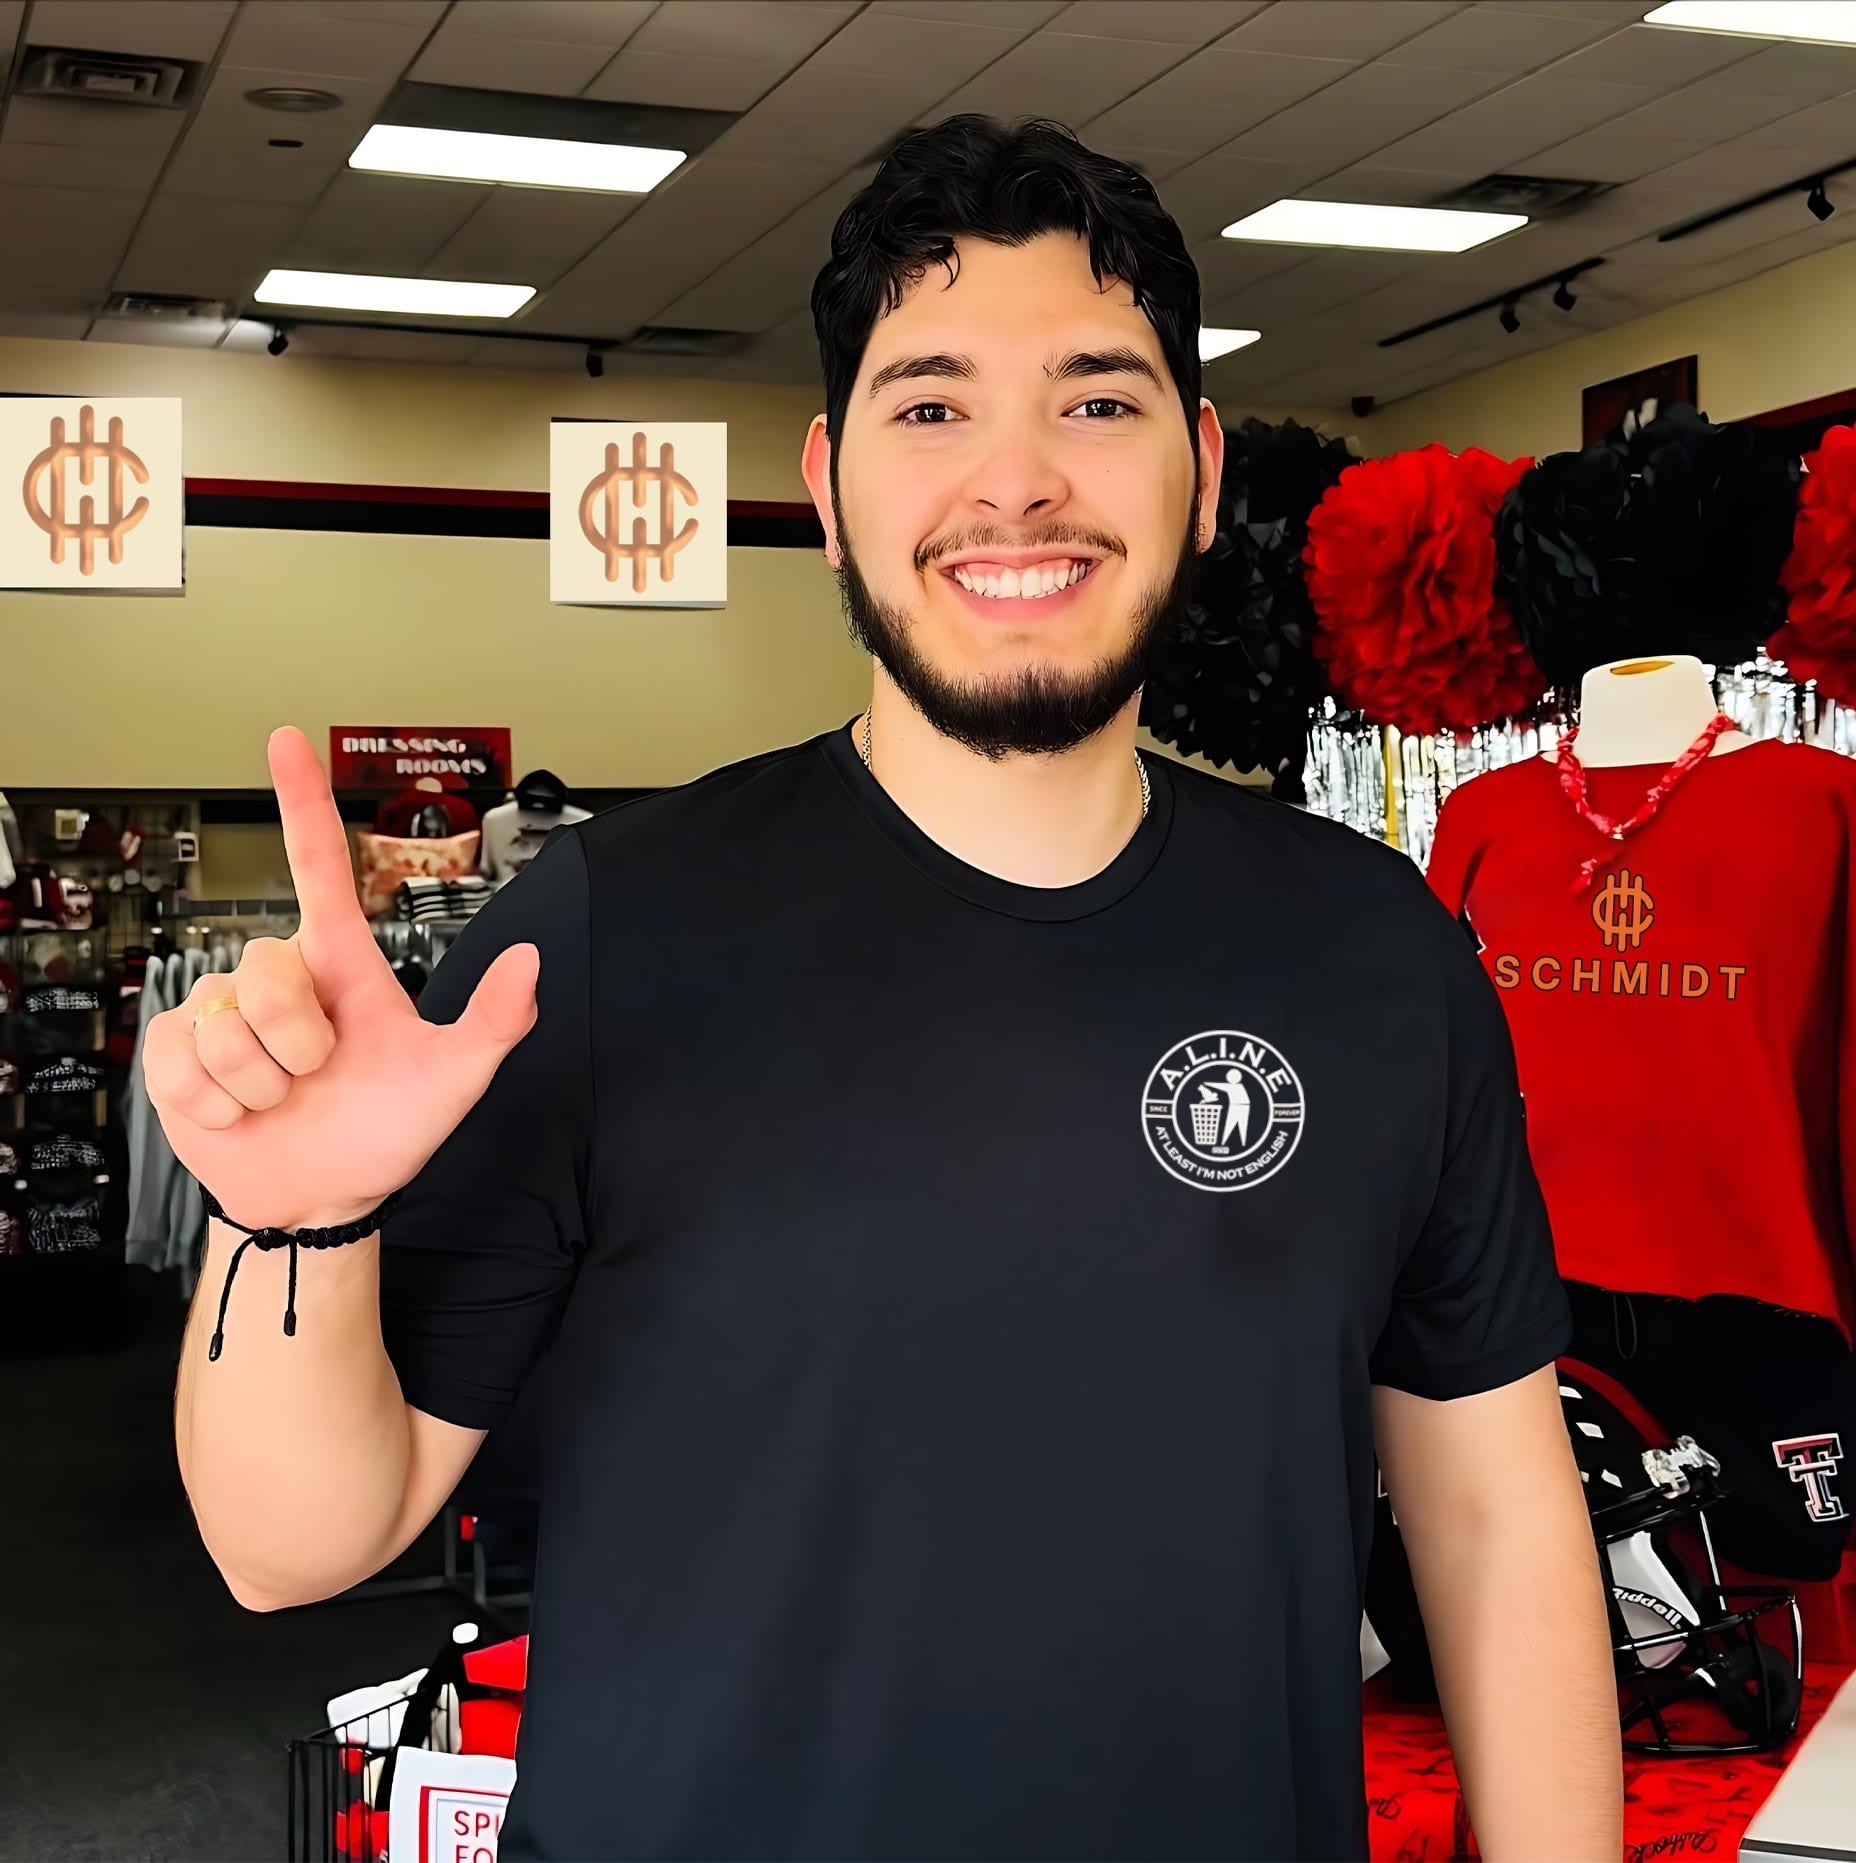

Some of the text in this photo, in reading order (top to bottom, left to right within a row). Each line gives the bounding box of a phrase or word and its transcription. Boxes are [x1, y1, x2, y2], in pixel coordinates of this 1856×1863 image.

[396, 759, 487, 775] ROOMS
[1494, 954, 1747, 999] SCHMIDT
[1159, 1037, 1293, 1094] A.L.I.N.E
[1149, 1105, 1169, 1114] SINCE
[1273, 1108, 1300, 1117] FOREVER
[1155, 1125, 1170, 1142] AT
[1162, 1140, 1198, 1173] LEAST
[1244, 1130, 1290, 1175] ENGLISH
[1196, 1166, 1216, 1179] I'M
[1216, 1166, 1246, 1180] NOT
